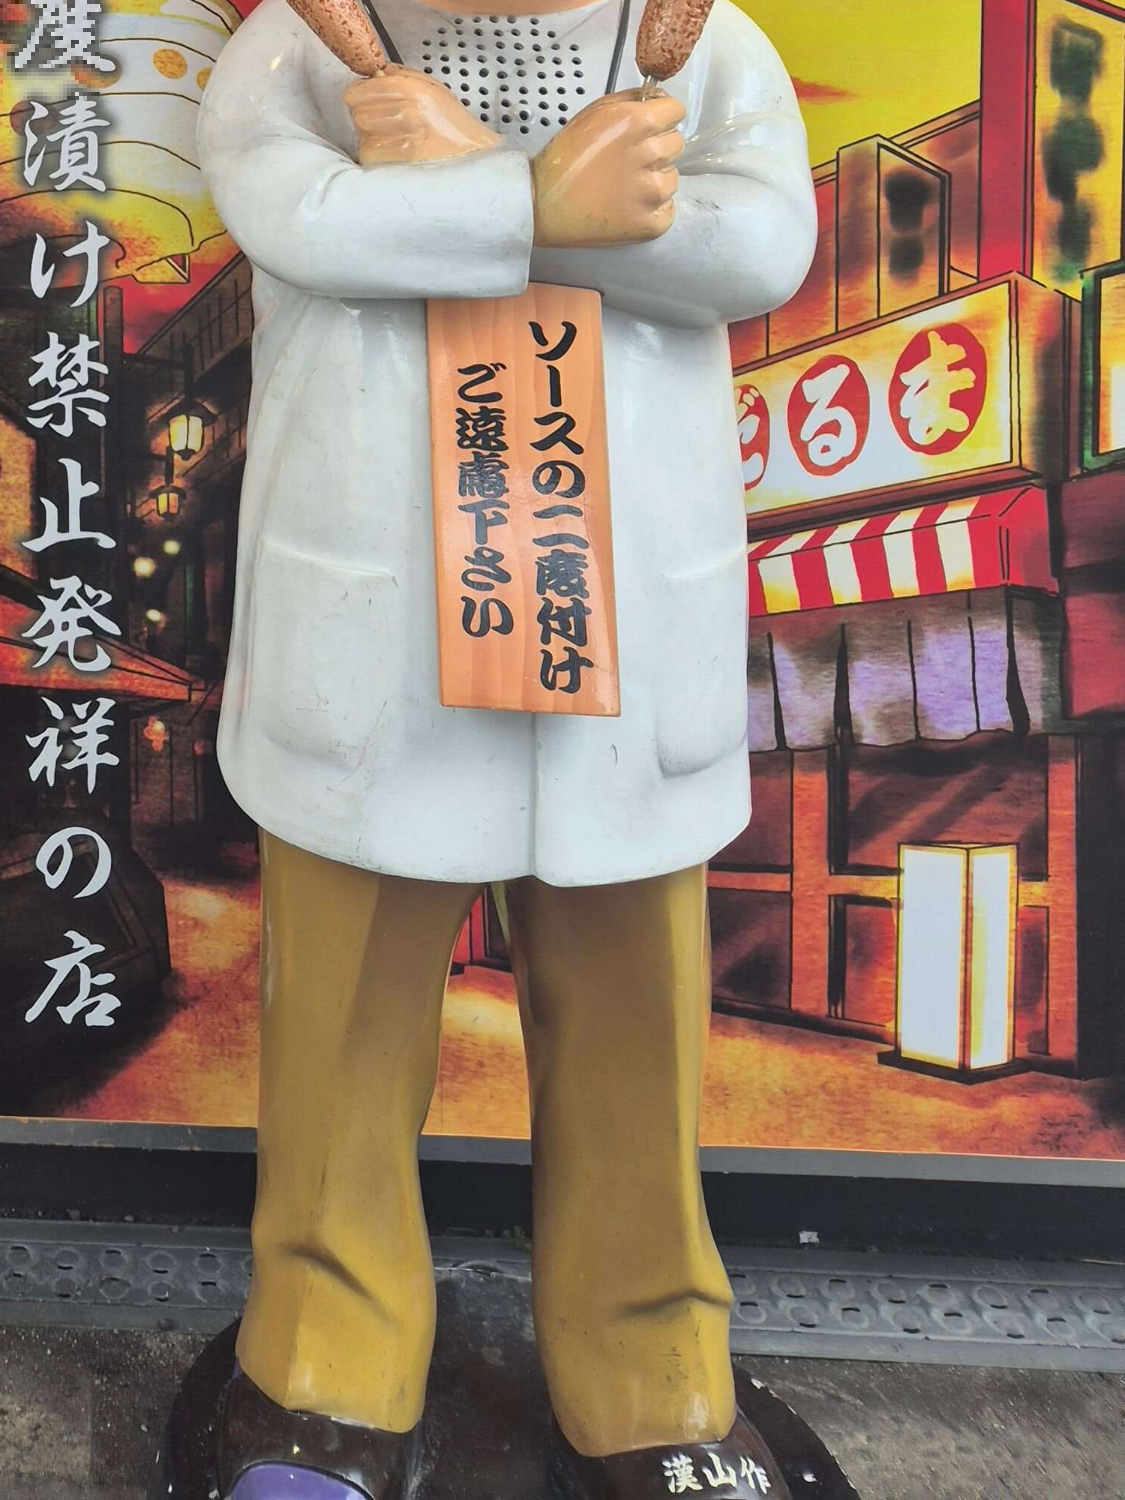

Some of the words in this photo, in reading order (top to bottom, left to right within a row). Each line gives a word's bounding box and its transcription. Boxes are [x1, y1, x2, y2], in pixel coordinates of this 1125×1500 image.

[454, 362, 515, 638] ご遠慮下さい
[527, 319, 594, 695] ソースの二度付け
[661, 1452, 772, 1495] 漢山作
